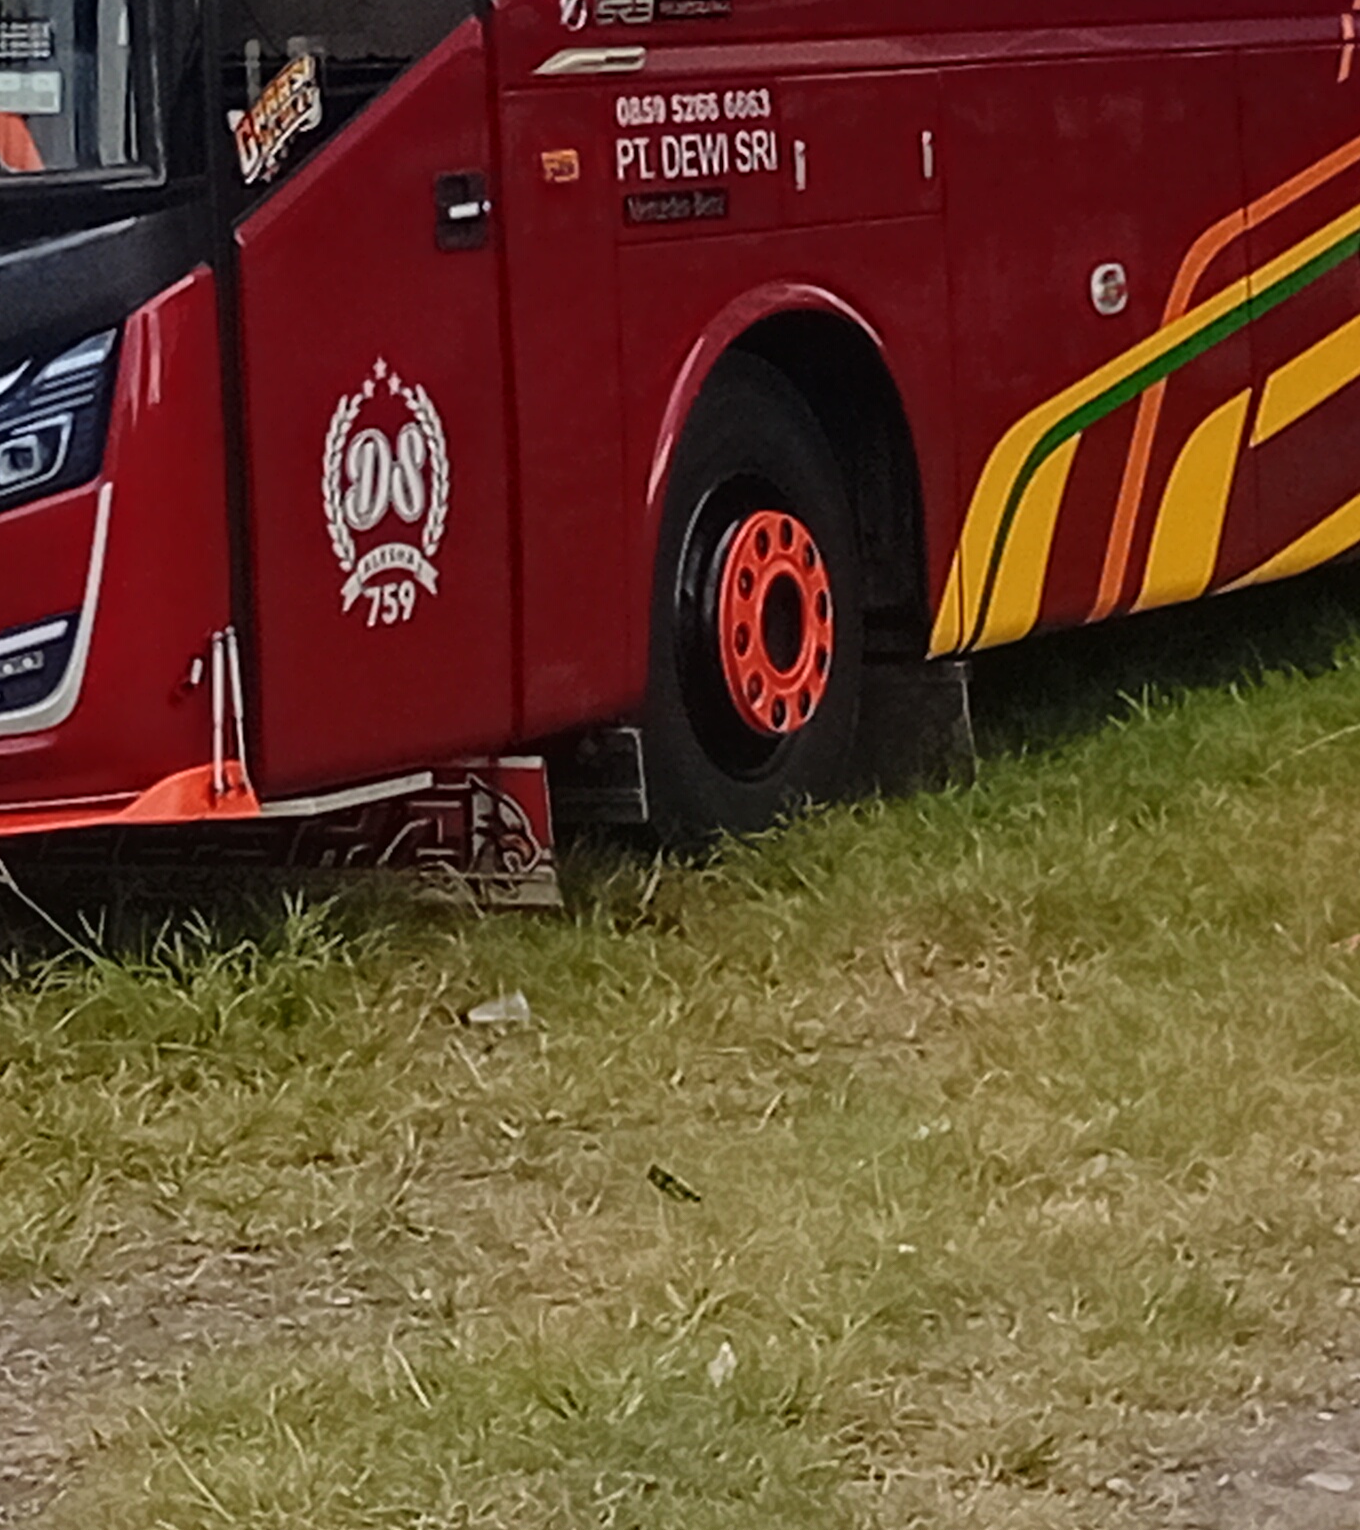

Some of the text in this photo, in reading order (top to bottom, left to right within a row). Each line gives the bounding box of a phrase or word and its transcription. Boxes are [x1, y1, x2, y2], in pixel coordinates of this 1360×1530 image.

[661, 132, 730, 179] DEWI
[735, 128, 778, 173] SRI
[363, 580, 415, 627] 759
